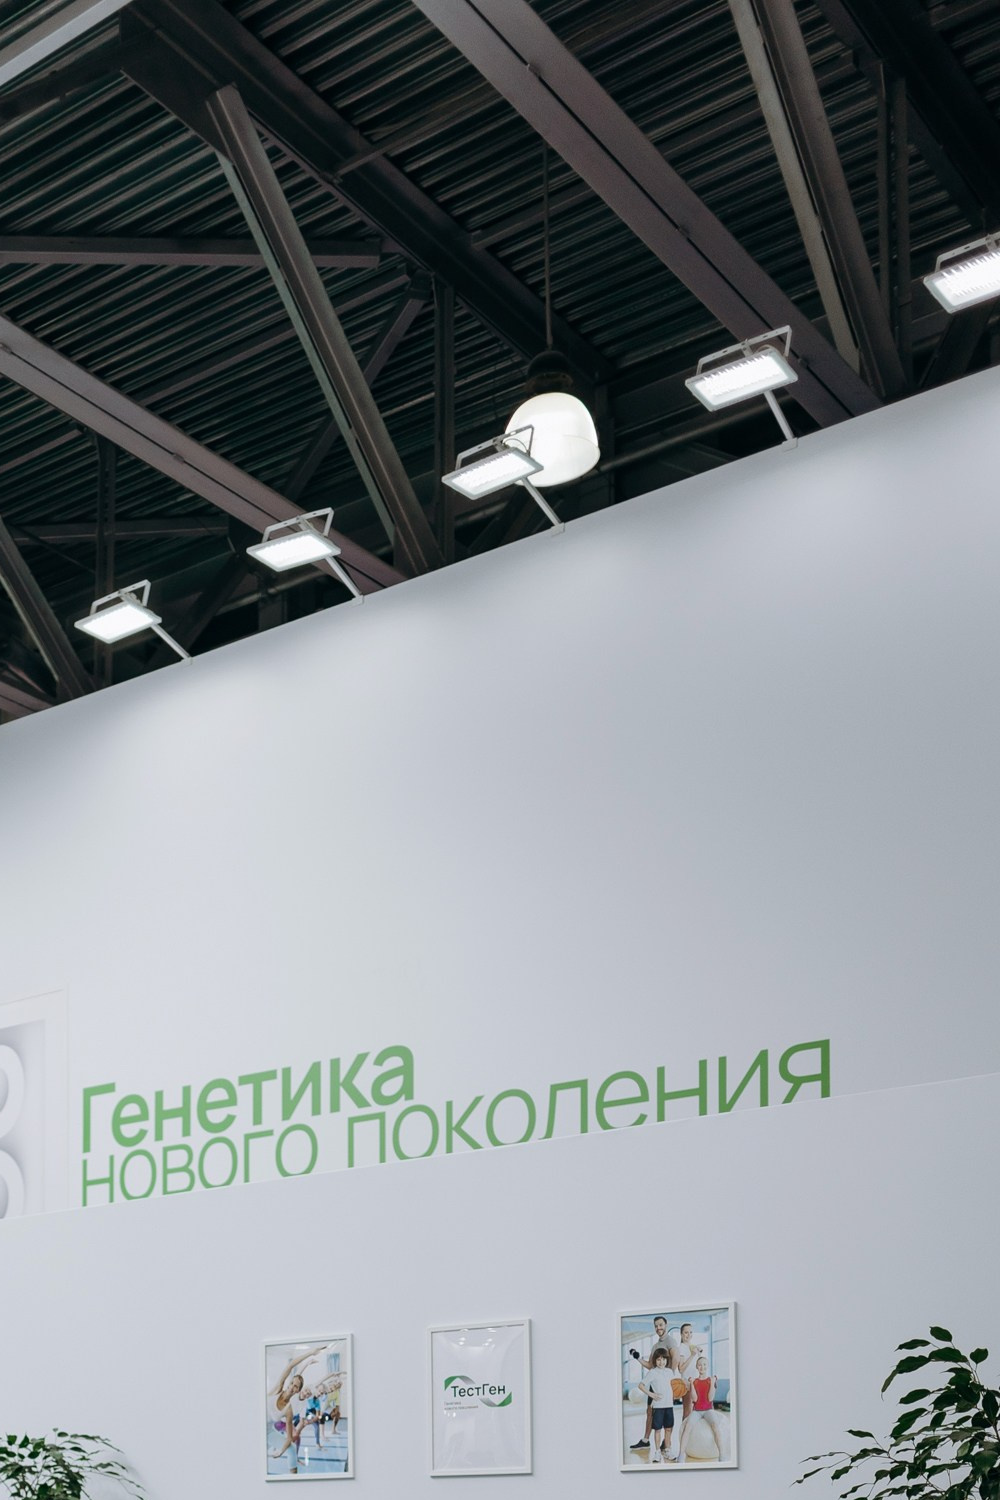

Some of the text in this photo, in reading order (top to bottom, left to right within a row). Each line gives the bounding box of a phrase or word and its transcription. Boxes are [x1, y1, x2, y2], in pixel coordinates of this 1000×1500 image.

[82, 1045, 414, 1153] Генетика
[347, 1038, 831, 1168] поколения
[450, 1383, 506, 1398] ТестГен
